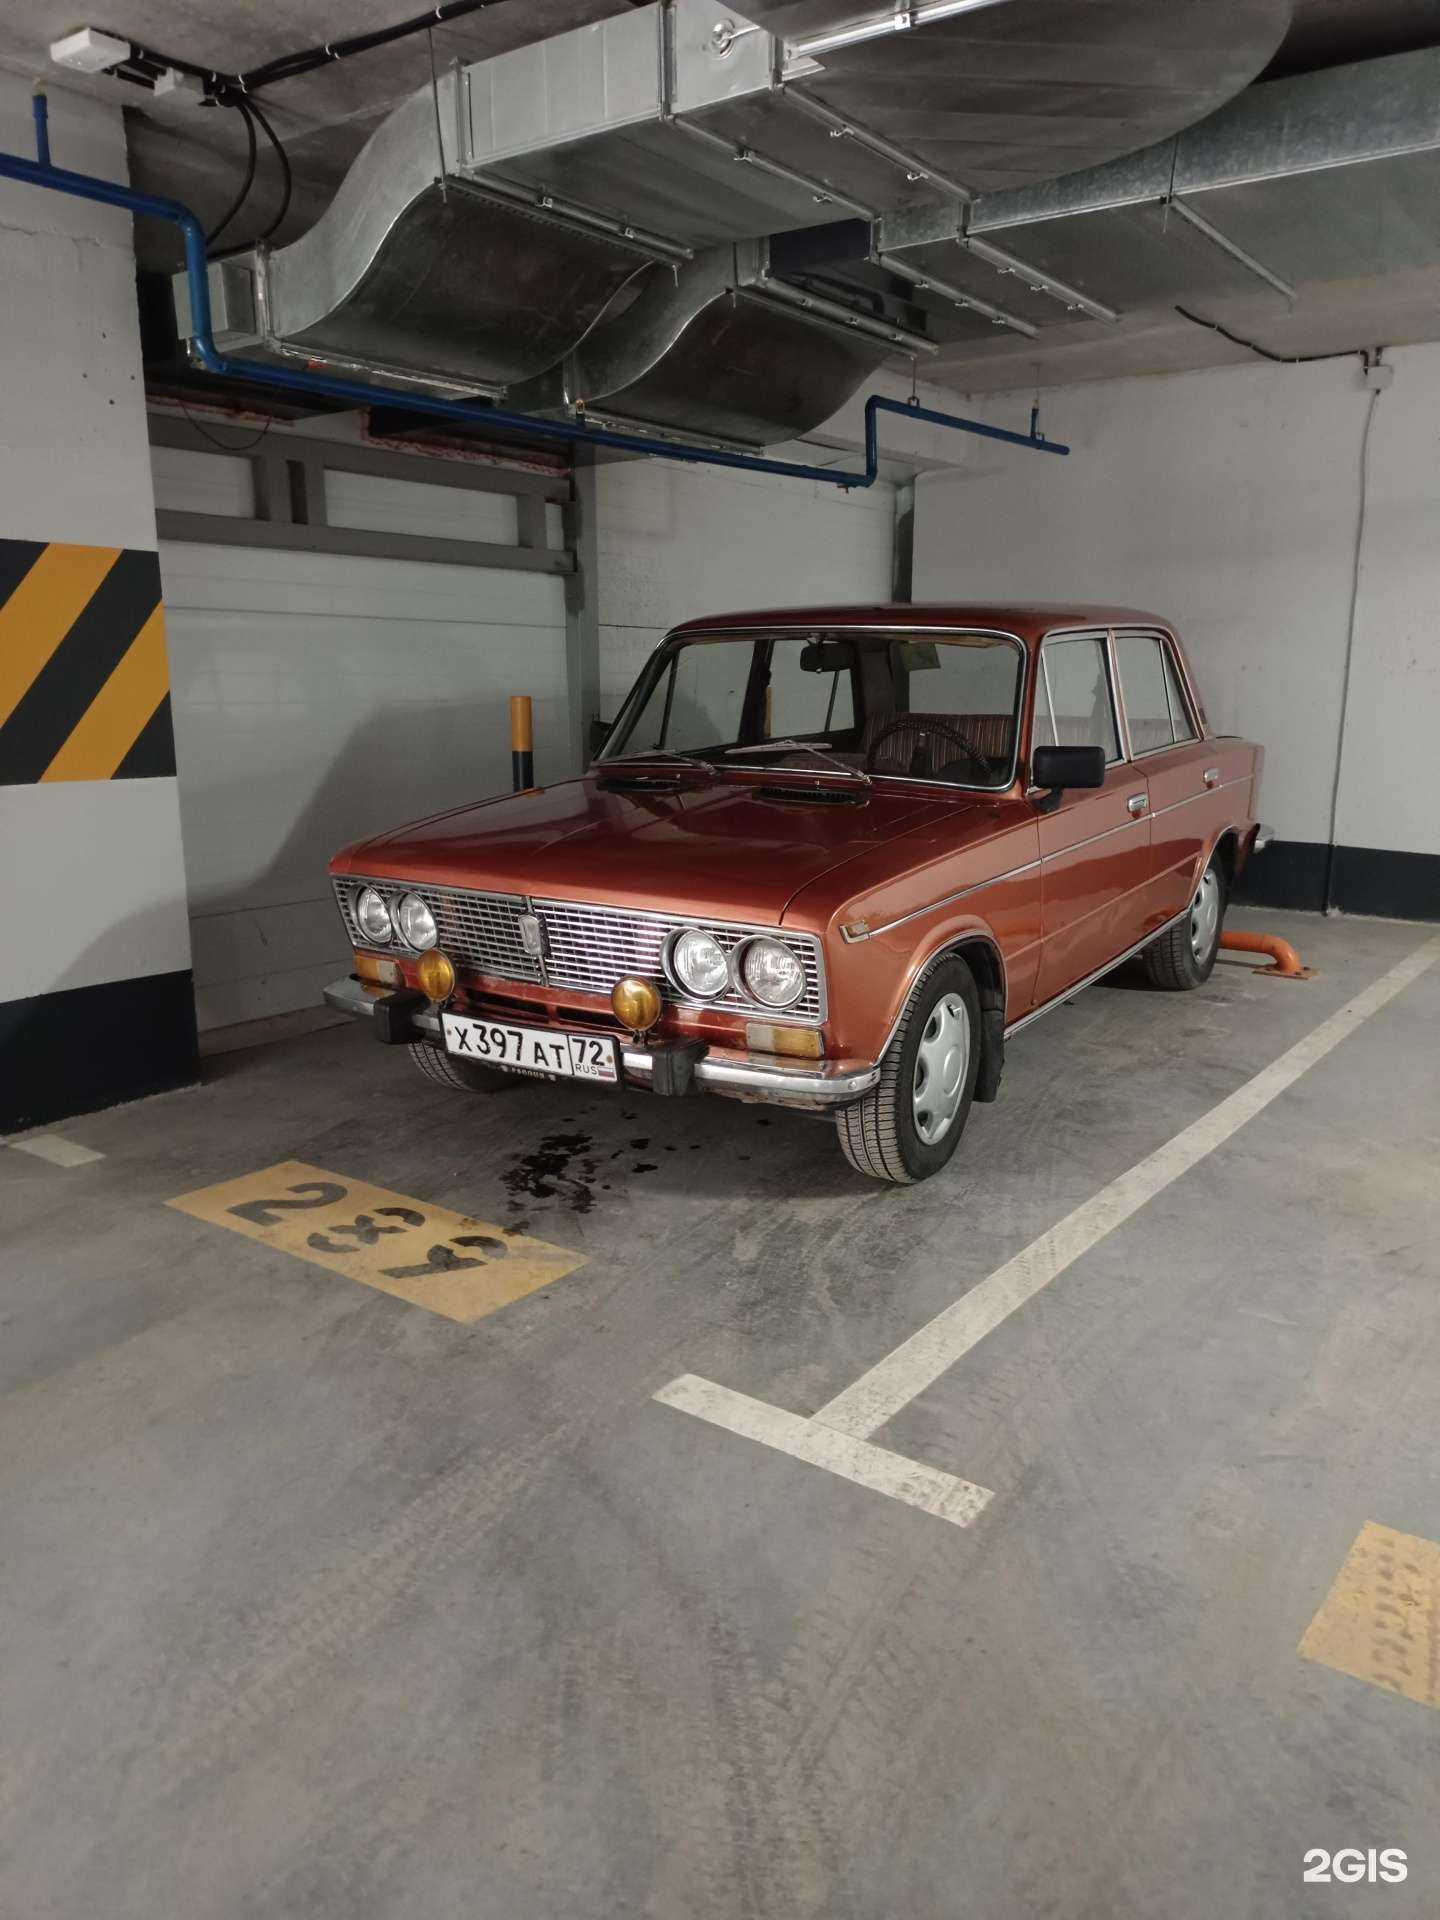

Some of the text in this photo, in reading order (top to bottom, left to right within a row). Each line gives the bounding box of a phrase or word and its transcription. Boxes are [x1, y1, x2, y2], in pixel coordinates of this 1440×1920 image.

[572, 1038, 605, 1066] 72
[574, 1063, 598, 1076] RUS
[226, 1182, 509, 1279] 289
